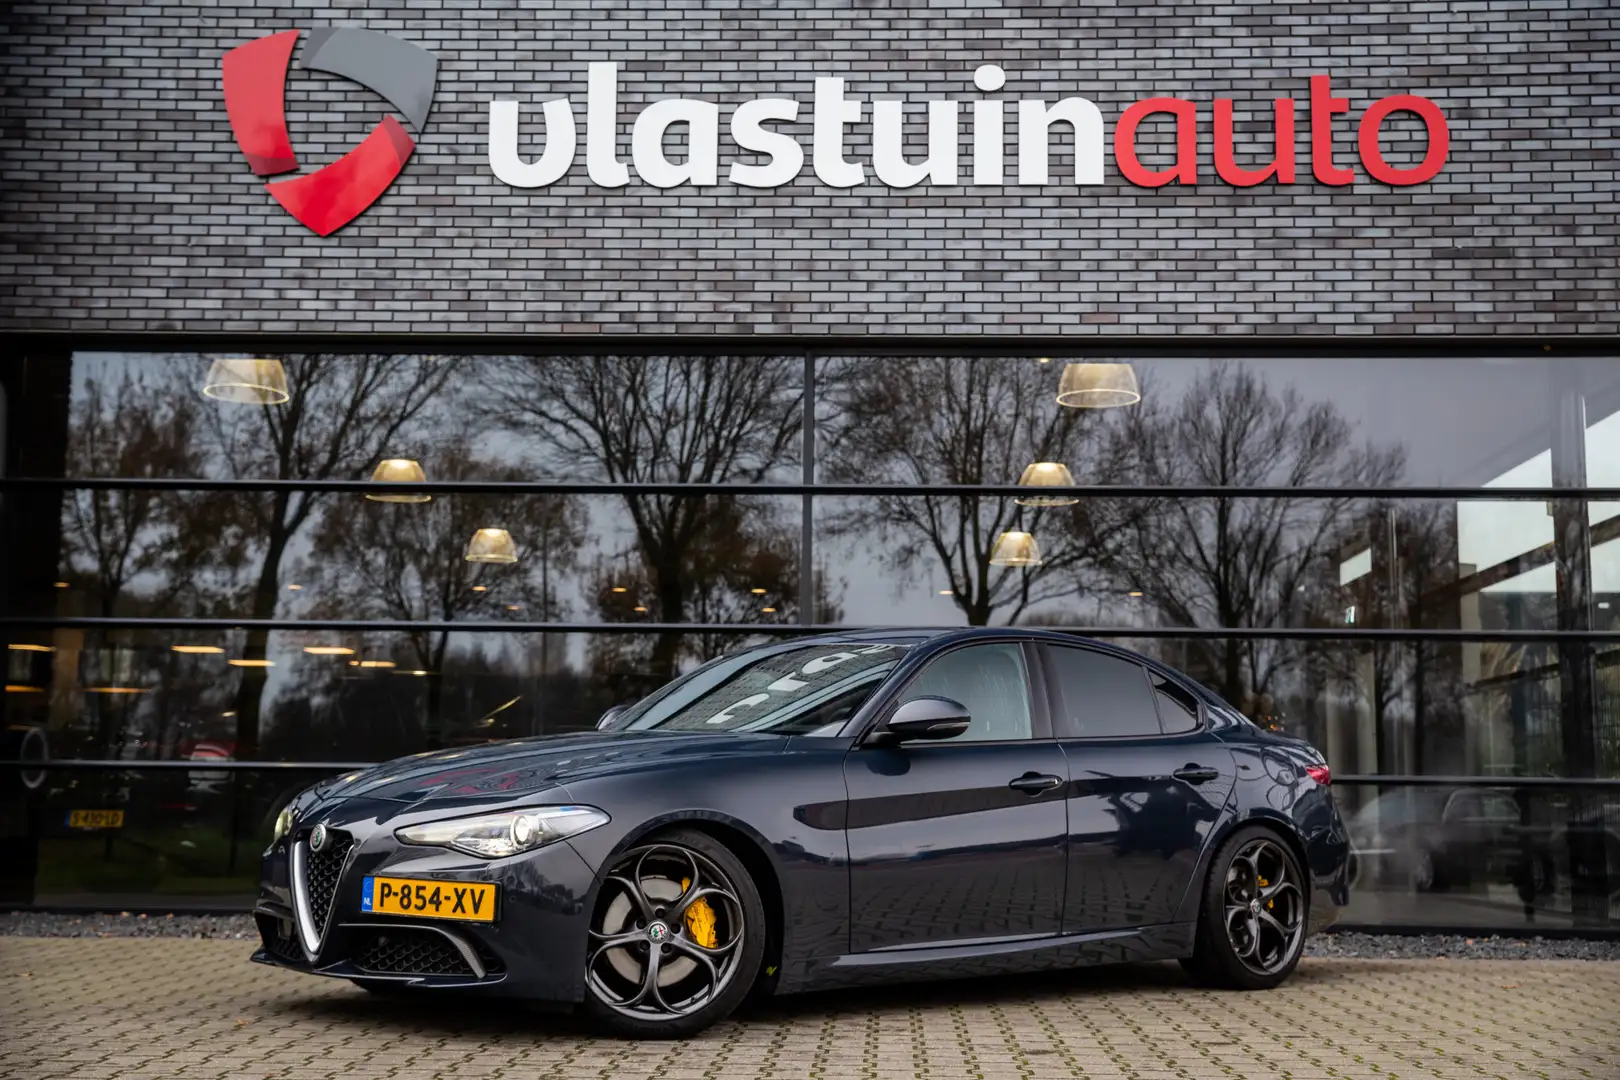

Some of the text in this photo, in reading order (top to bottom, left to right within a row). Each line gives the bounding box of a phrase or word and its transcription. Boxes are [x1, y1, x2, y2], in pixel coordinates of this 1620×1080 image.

[488, 61, 1450, 188] vlastuinauto
[363, 882, 485, 914] NL P-854-XV
